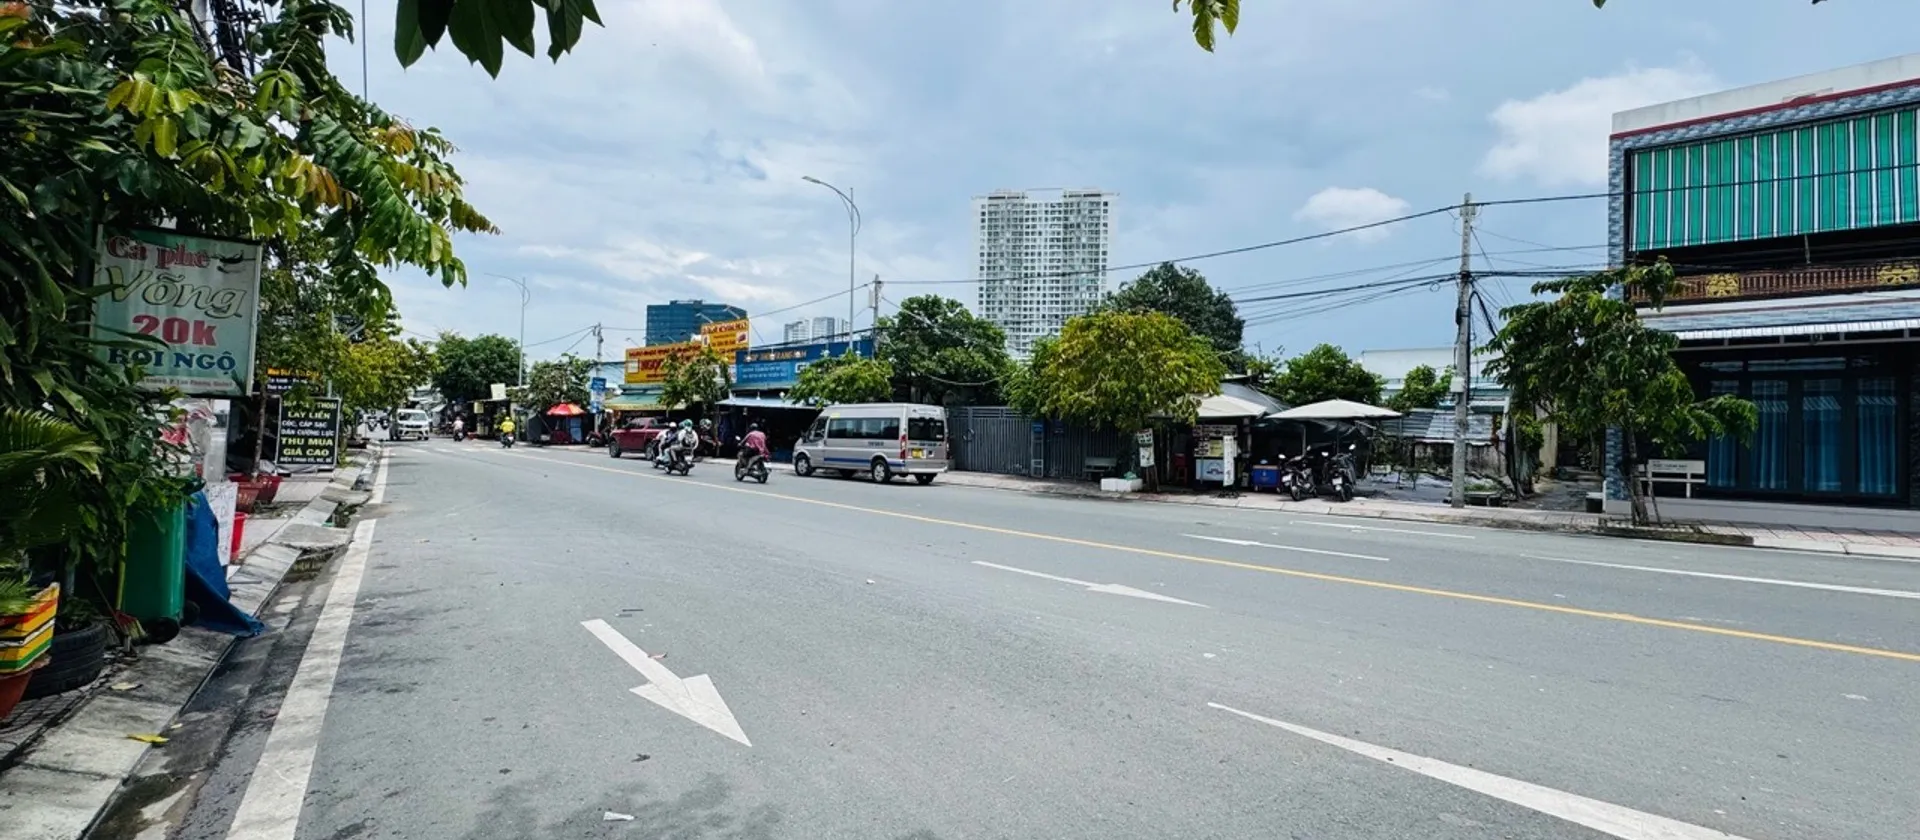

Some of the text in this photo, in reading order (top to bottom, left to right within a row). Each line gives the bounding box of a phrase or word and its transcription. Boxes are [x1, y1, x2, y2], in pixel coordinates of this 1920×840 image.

[105, 265, 247, 319] Võng
[132, 314, 217, 346] 20k
[174, 351, 236, 375] NGỘ
[281, 437, 333, 446] THU MUA
[283, 447, 330, 457] GIÁ CAO
